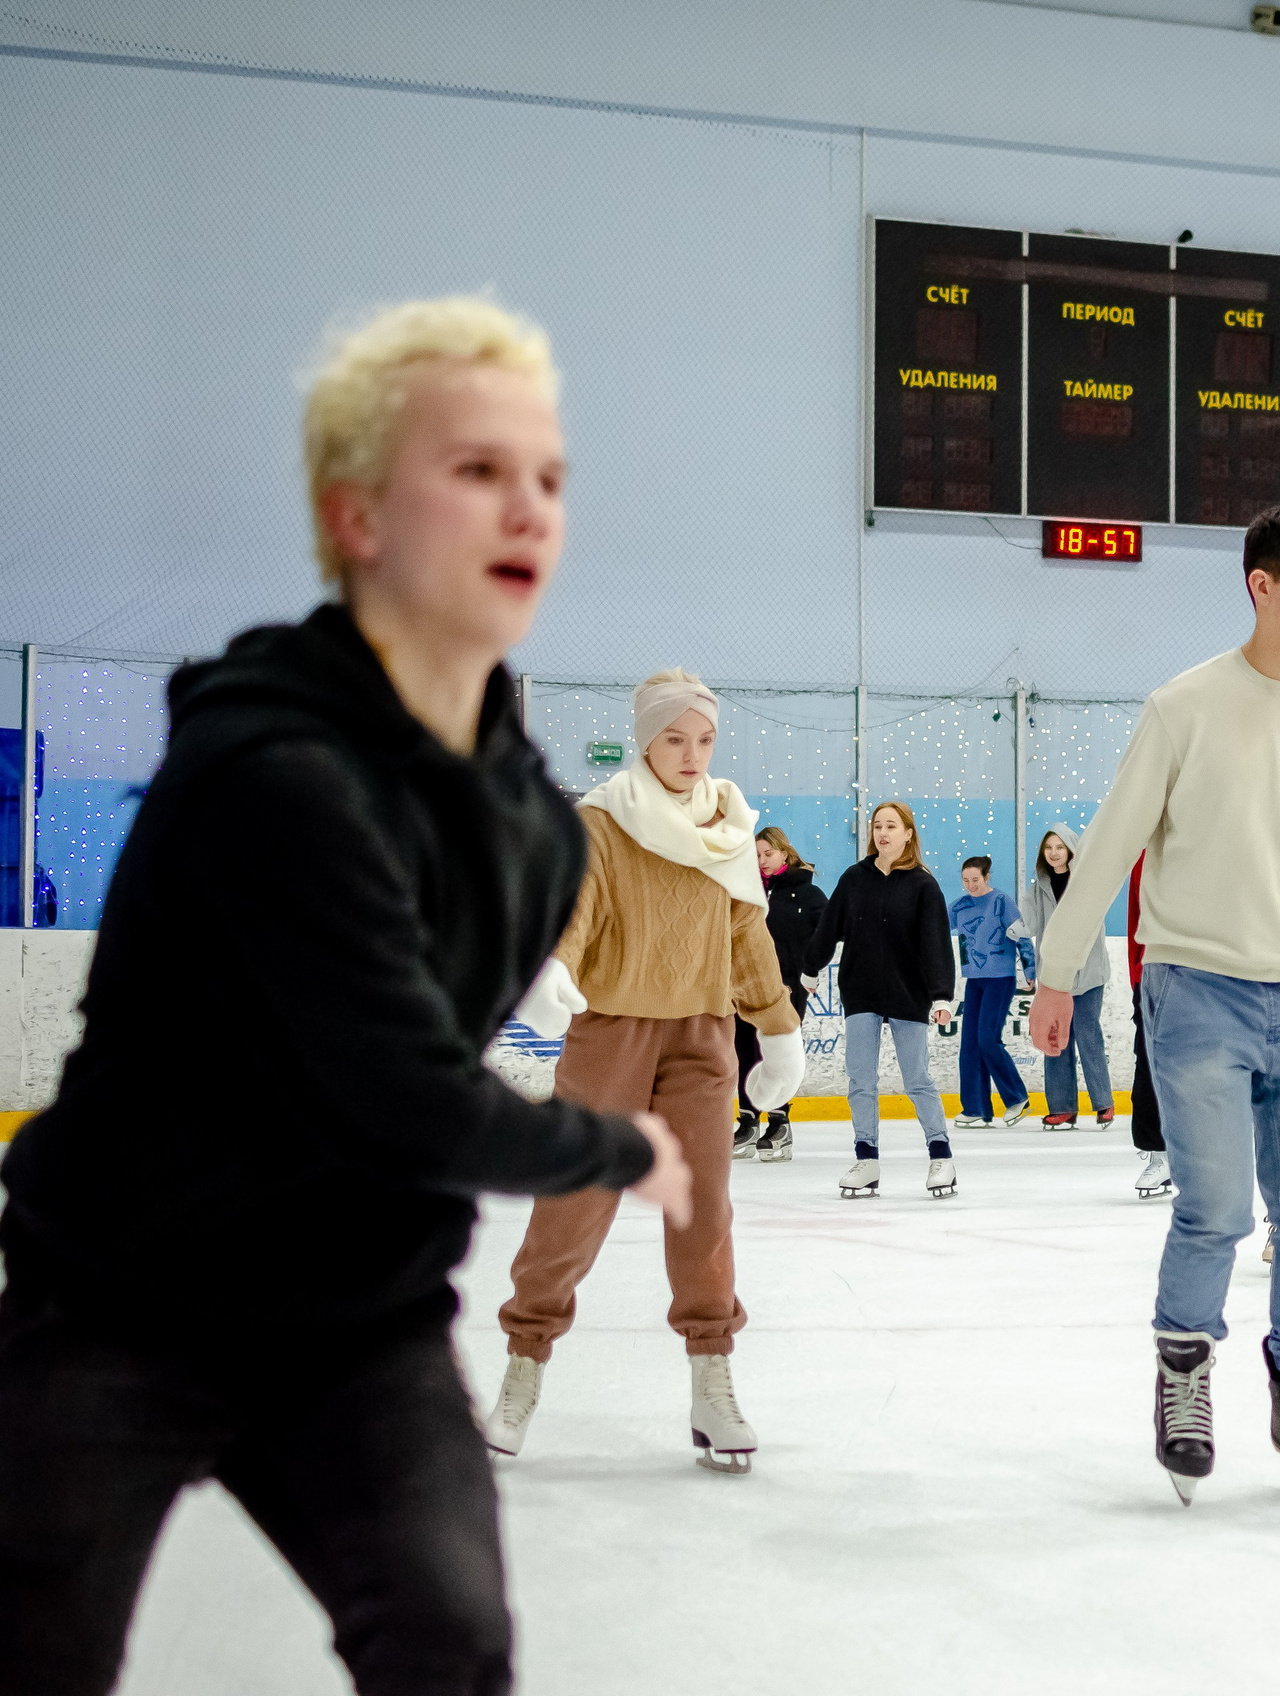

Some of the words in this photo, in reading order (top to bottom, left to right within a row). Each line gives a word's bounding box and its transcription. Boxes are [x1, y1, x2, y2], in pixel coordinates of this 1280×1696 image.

[926, 284, 970, 305] СЧЁТ
[1062, 302, 1136, 327] ПЕРИОД
[1224, 308, 1265, 328] СЧЁТ
[899, 368, 998, 392] УДАЛЕНИЯ
[1063, 378, 1134, 401] ТАЙМЕР
[1059, 528, 1135, 555] 18-57
